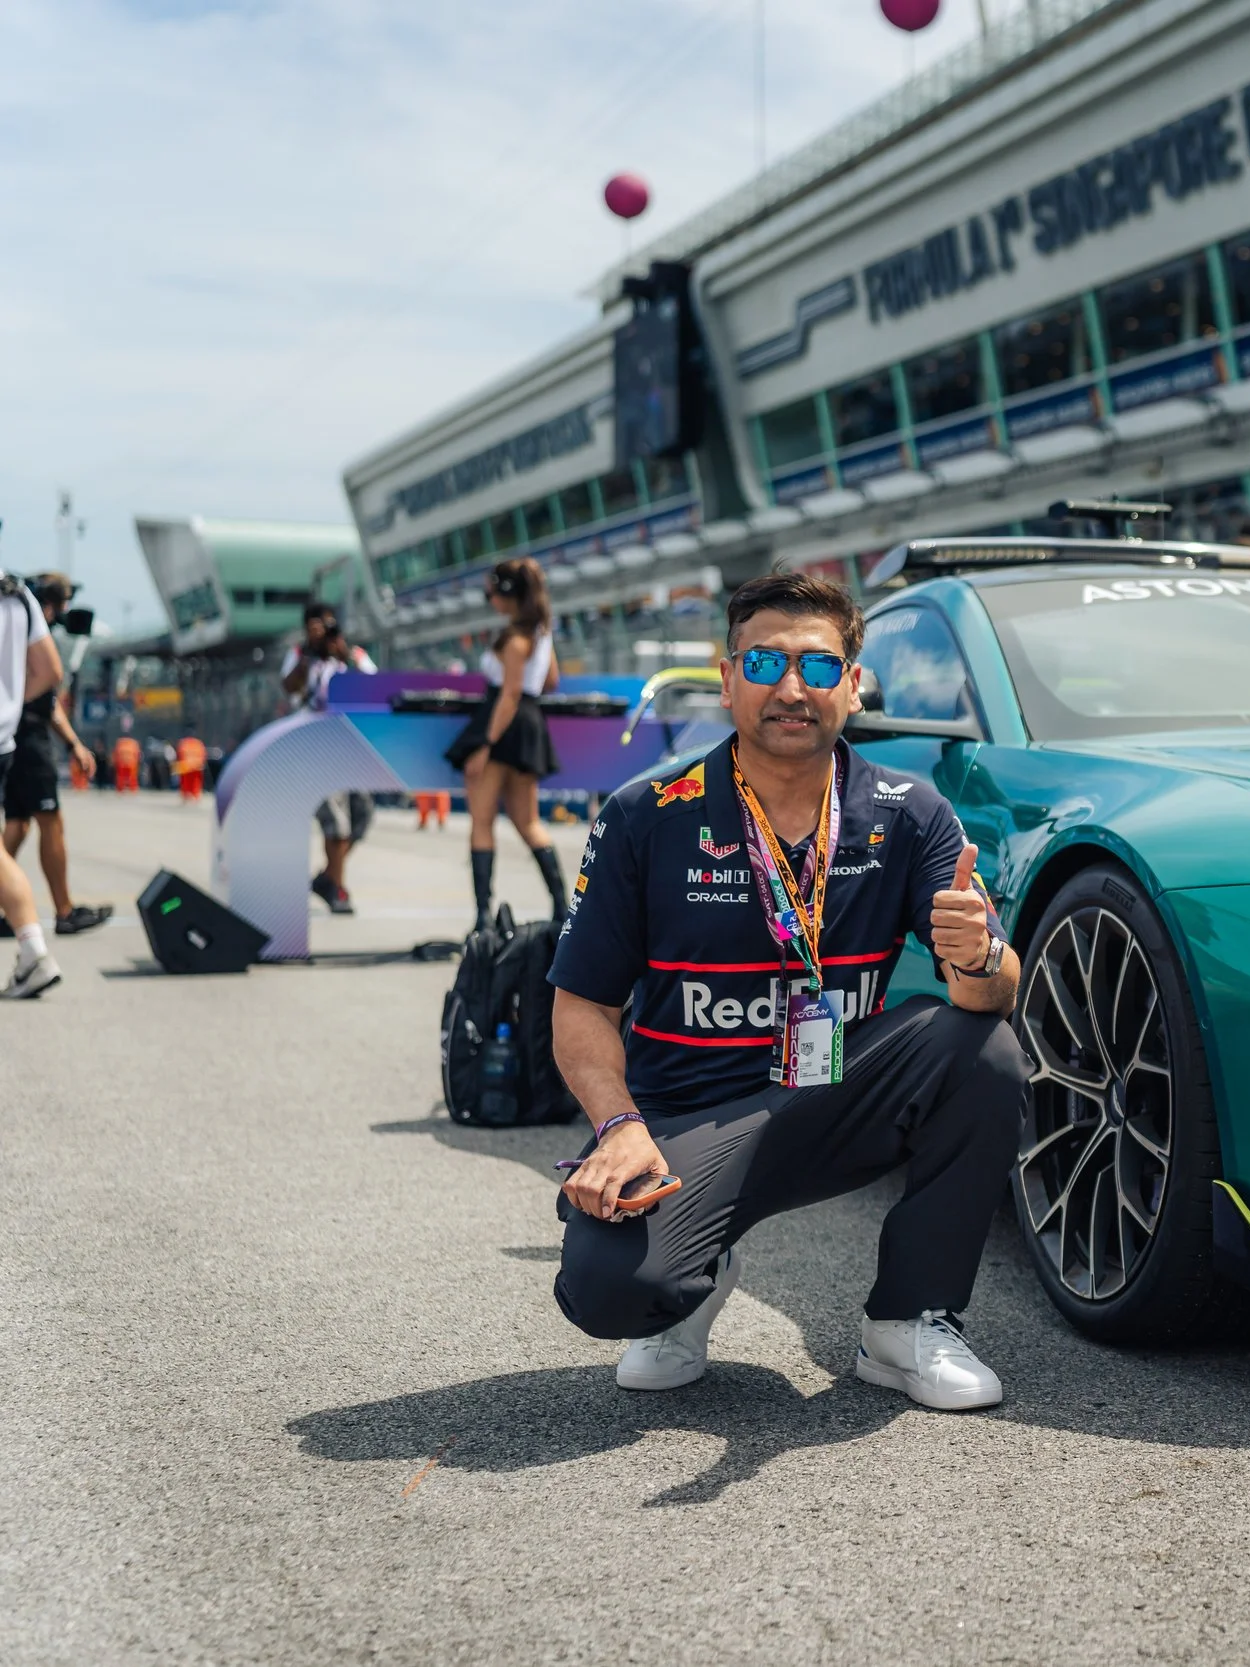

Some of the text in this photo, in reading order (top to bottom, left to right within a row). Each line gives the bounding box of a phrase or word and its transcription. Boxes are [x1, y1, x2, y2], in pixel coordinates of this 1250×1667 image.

[863, 213, 999, 326] FORMULA
[1028, 96, 1244, 256] SINGAPORE
[686, 892, 749, 903] ORACLE
[687, 868, 733, 884] Mobil
[682, 977, 777, 1029] Red
[792, 1008, 829, 1019] ACADEMY
[789, 1024, 800, 1087] 2025
[833, 1026, 842, 1081] PADDOCK
